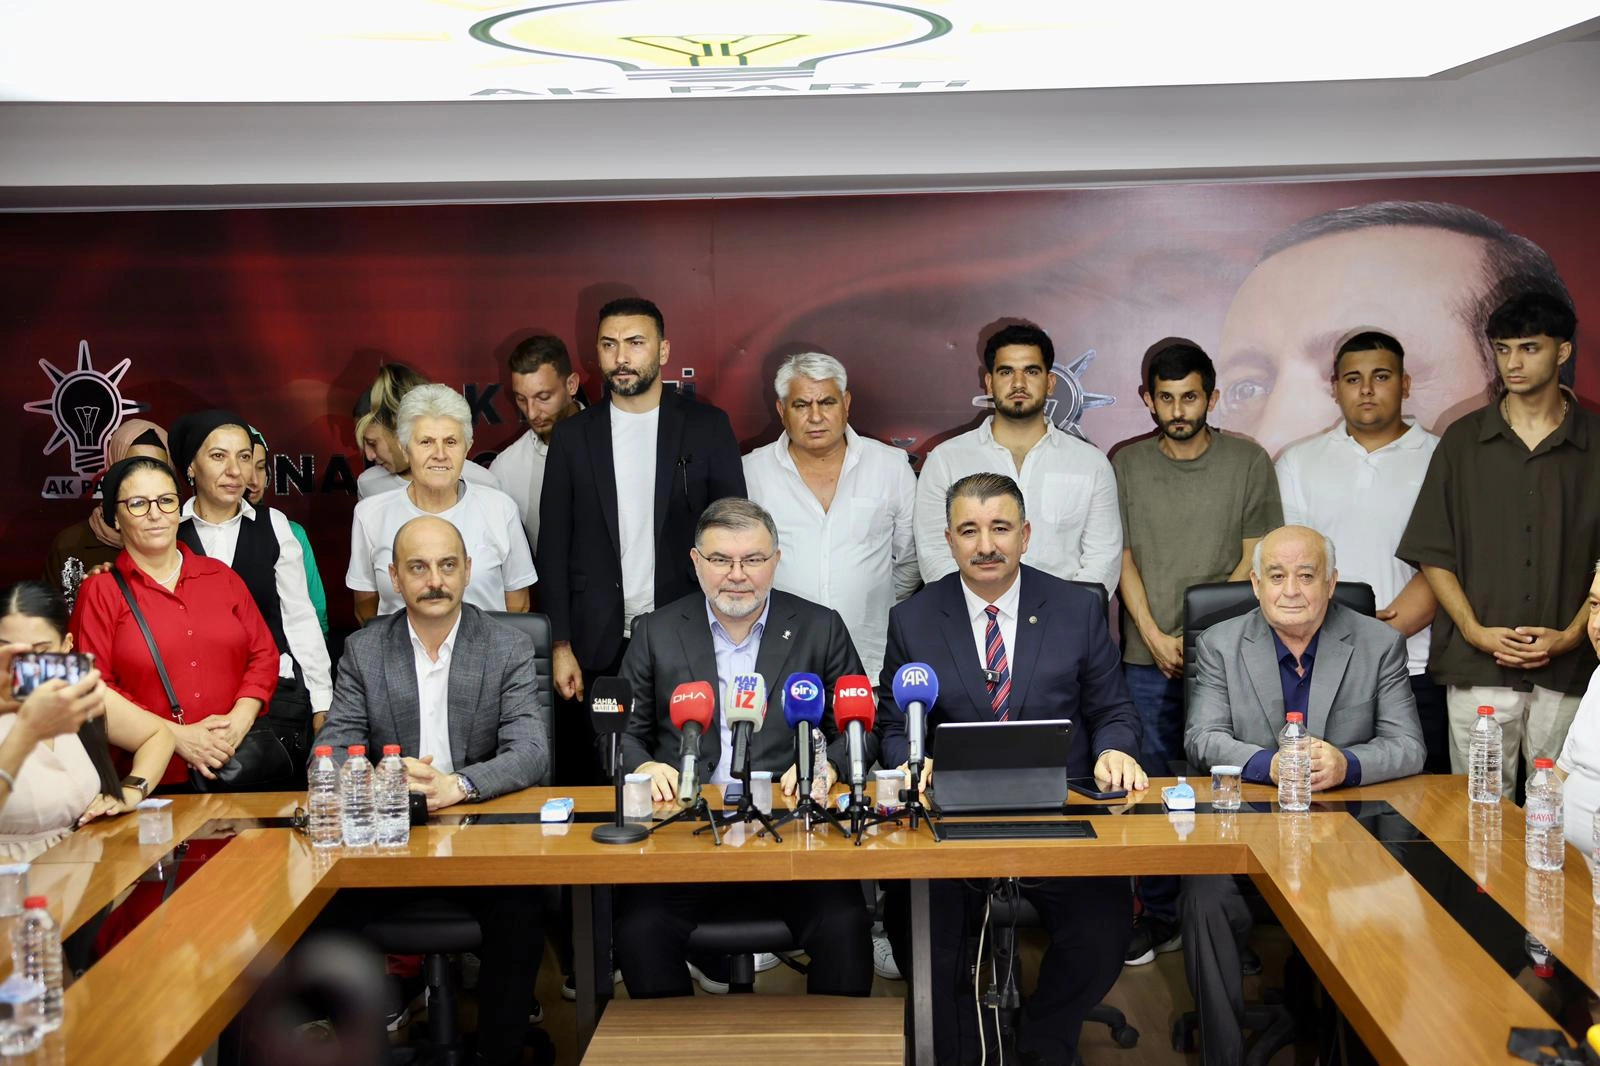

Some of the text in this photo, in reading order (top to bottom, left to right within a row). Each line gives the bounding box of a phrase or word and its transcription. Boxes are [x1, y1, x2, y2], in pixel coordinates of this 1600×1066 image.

[469, 87, 617, 96] AK
[46, 480, 74, 494] AK
[735, 676, 757, 684] MAN
[902, 670, 928, 687] AA
[672, 691, 706, 704] DHA
[840, 688, 868, 698] NEO
